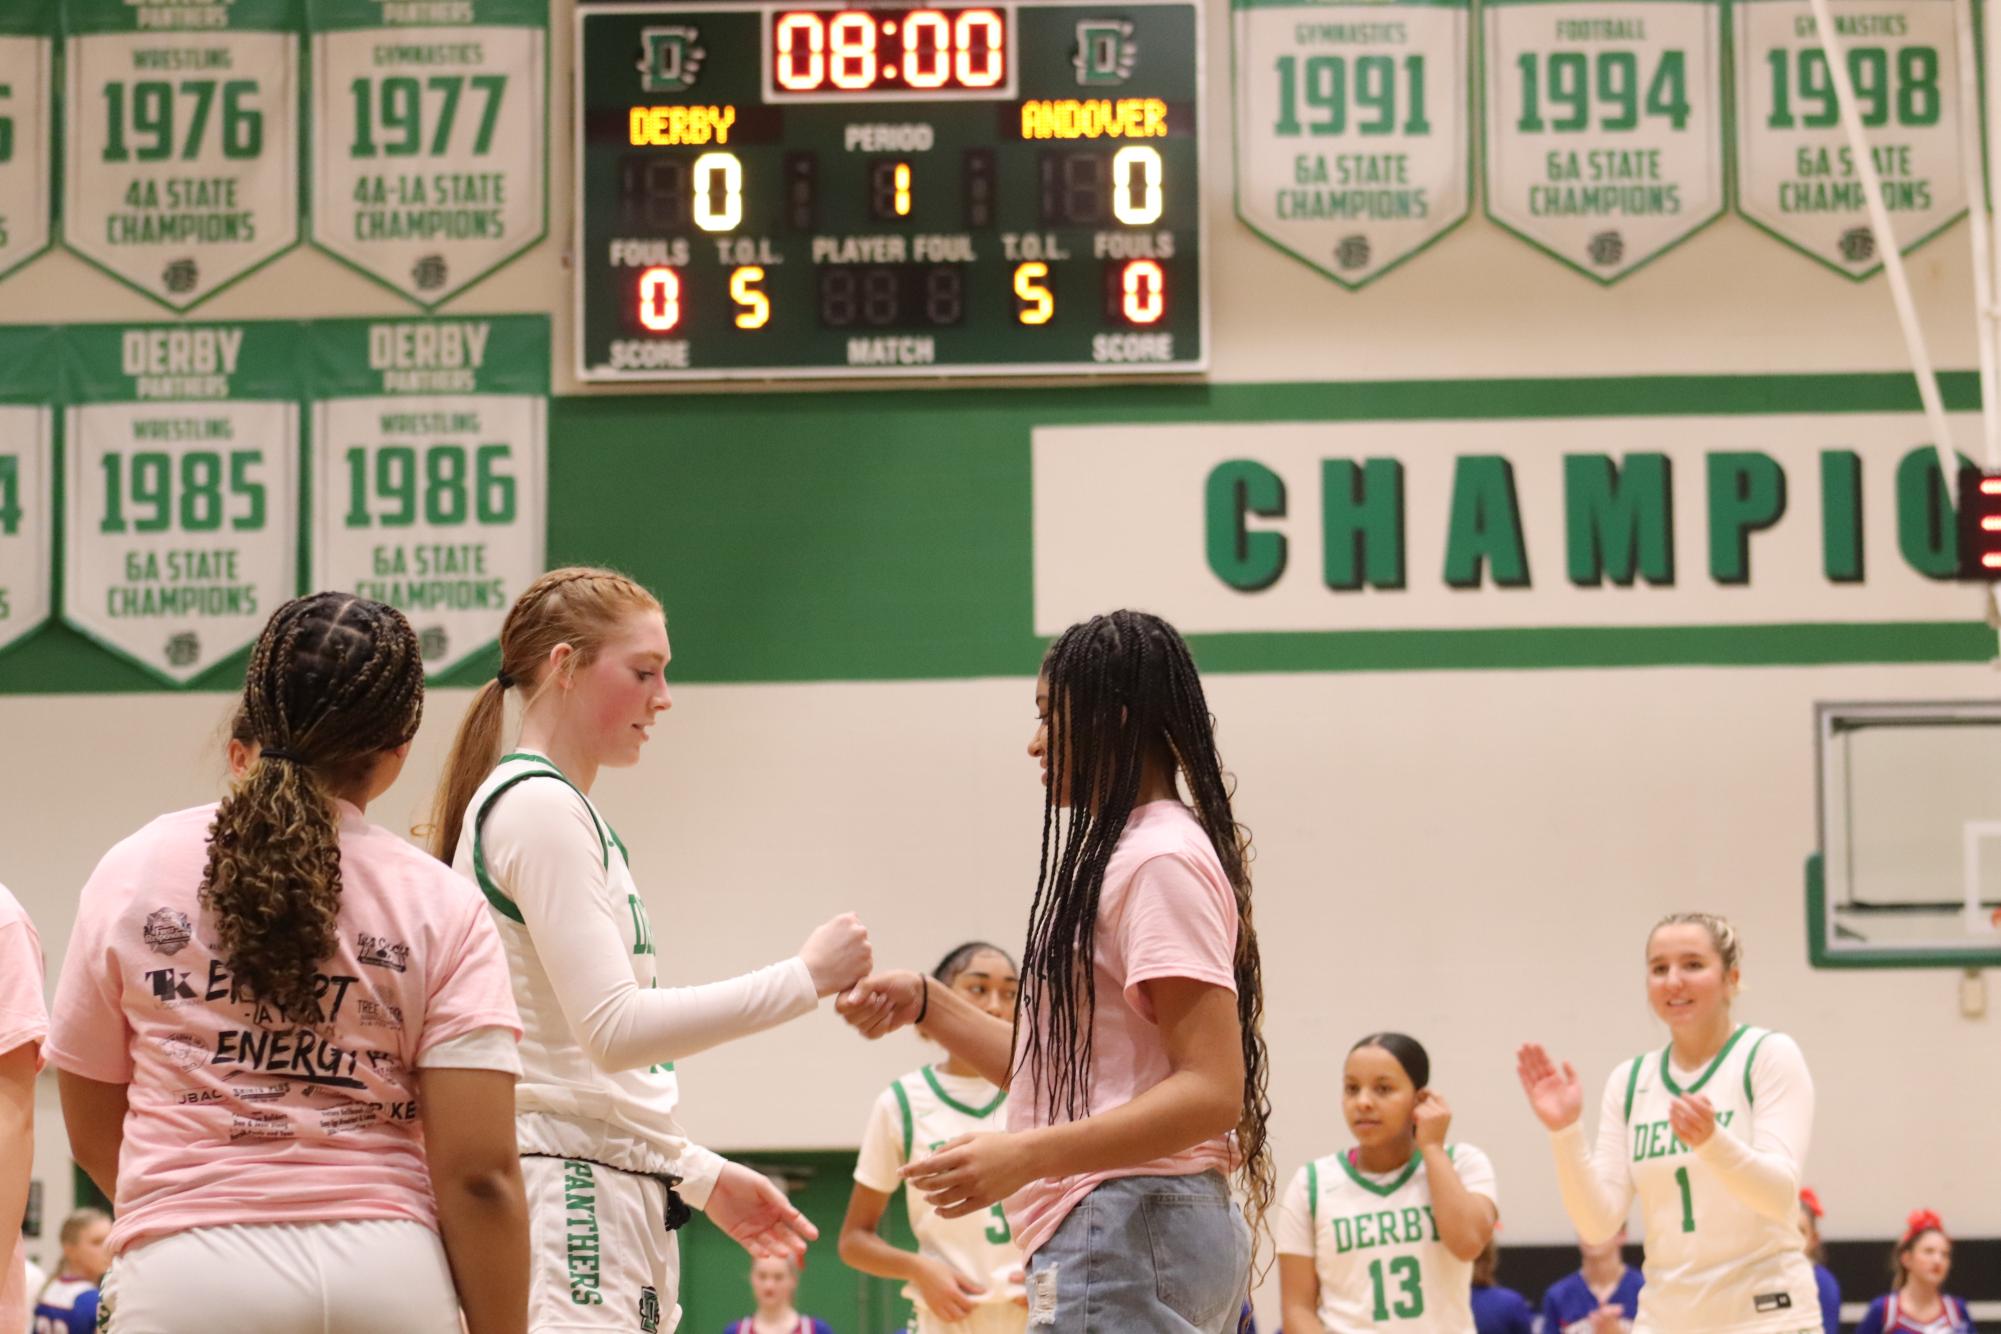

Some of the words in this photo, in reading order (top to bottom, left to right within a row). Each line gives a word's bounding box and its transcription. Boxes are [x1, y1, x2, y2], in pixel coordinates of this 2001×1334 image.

[1556, 20, 1645, 40] FOOTBALL
[1794, 15, 1907, 36] GYNASTICS
[775, 9, 1004, 90] 08:00
[1274, 55, 1431, 135] 1991
[1518, 50, 1690, 131] 1994
[1768, 47, 1940, 128] 1998
[102, 80, 263, 162] 1976
[350, 75, 508, 157] 1977
[629, 107, 735, 145] DERBY
[1021, 98, 1167, 139] ANDOVER
[845, 124, 933, 152] PERIOD
[1295, 154, 1328, 184] 6A
[1336, 154, 1408, 184] STATE
[1547, 150, 1580, 181] 6A
[1587, 149, 1660, 180] STATE
[1797, 147, 1830, 176] 6A
[1837, 145, 1911, 176] SATE
[125, 180, 158, 209] 4A
[167, 177, 238, 209] STATE
[354, 175, 425, 206] 4A-1A
[433, 173, 506, 205] STATE
[692, 152, 742, 231] 0
[894, 163, 911, 216] 1
[1113, 146, 1163, 225] 0
[1530, 184, 1681, 215] CHAMPIONS
[1780, 180, 1932, 212] CHAMPONS
[1276, 189, 1427, 219] CHAMPIONS
[107, 212, 255, 245] CHAMPIONS
[355, 208, 505, 242] CHAMPIONS
[610, 239, 689, 267] FOULS
[812, 236, 906, 264] PLAYER
[914, 235, 976, 262] FOUL
[1095, 233, 1174, 259] FOULS
[639, 266, 680, 331] 0
[1122, 260, 1164, 324] 0
[122, 329, 243, 374] DERBY
[369, 324, 489, 369] DERBY
[610, 340, 689, 368] SCORE
[847, 337, 934, 365] MATCH
[1093, 334, 1172, 362] SCORE
[100, 450, 266, 532] 1985
[345, 445, 517, 527] 1986
[126, 552, 159, 581] 6A
[167, 550, 239, 580] STATE
[373, 546, 406, 575] 6A
[414, 545, 487, 575] STATE
[108, 585, 257, 618] CHAMPIONS
[1633, 1110, 1734, 1162] DERY
[1675, 1166, 1696, 1233] 1
[564, 1161, 603, 1306] PANTHERS
[1368, 1255, 1424, 1322] 13
